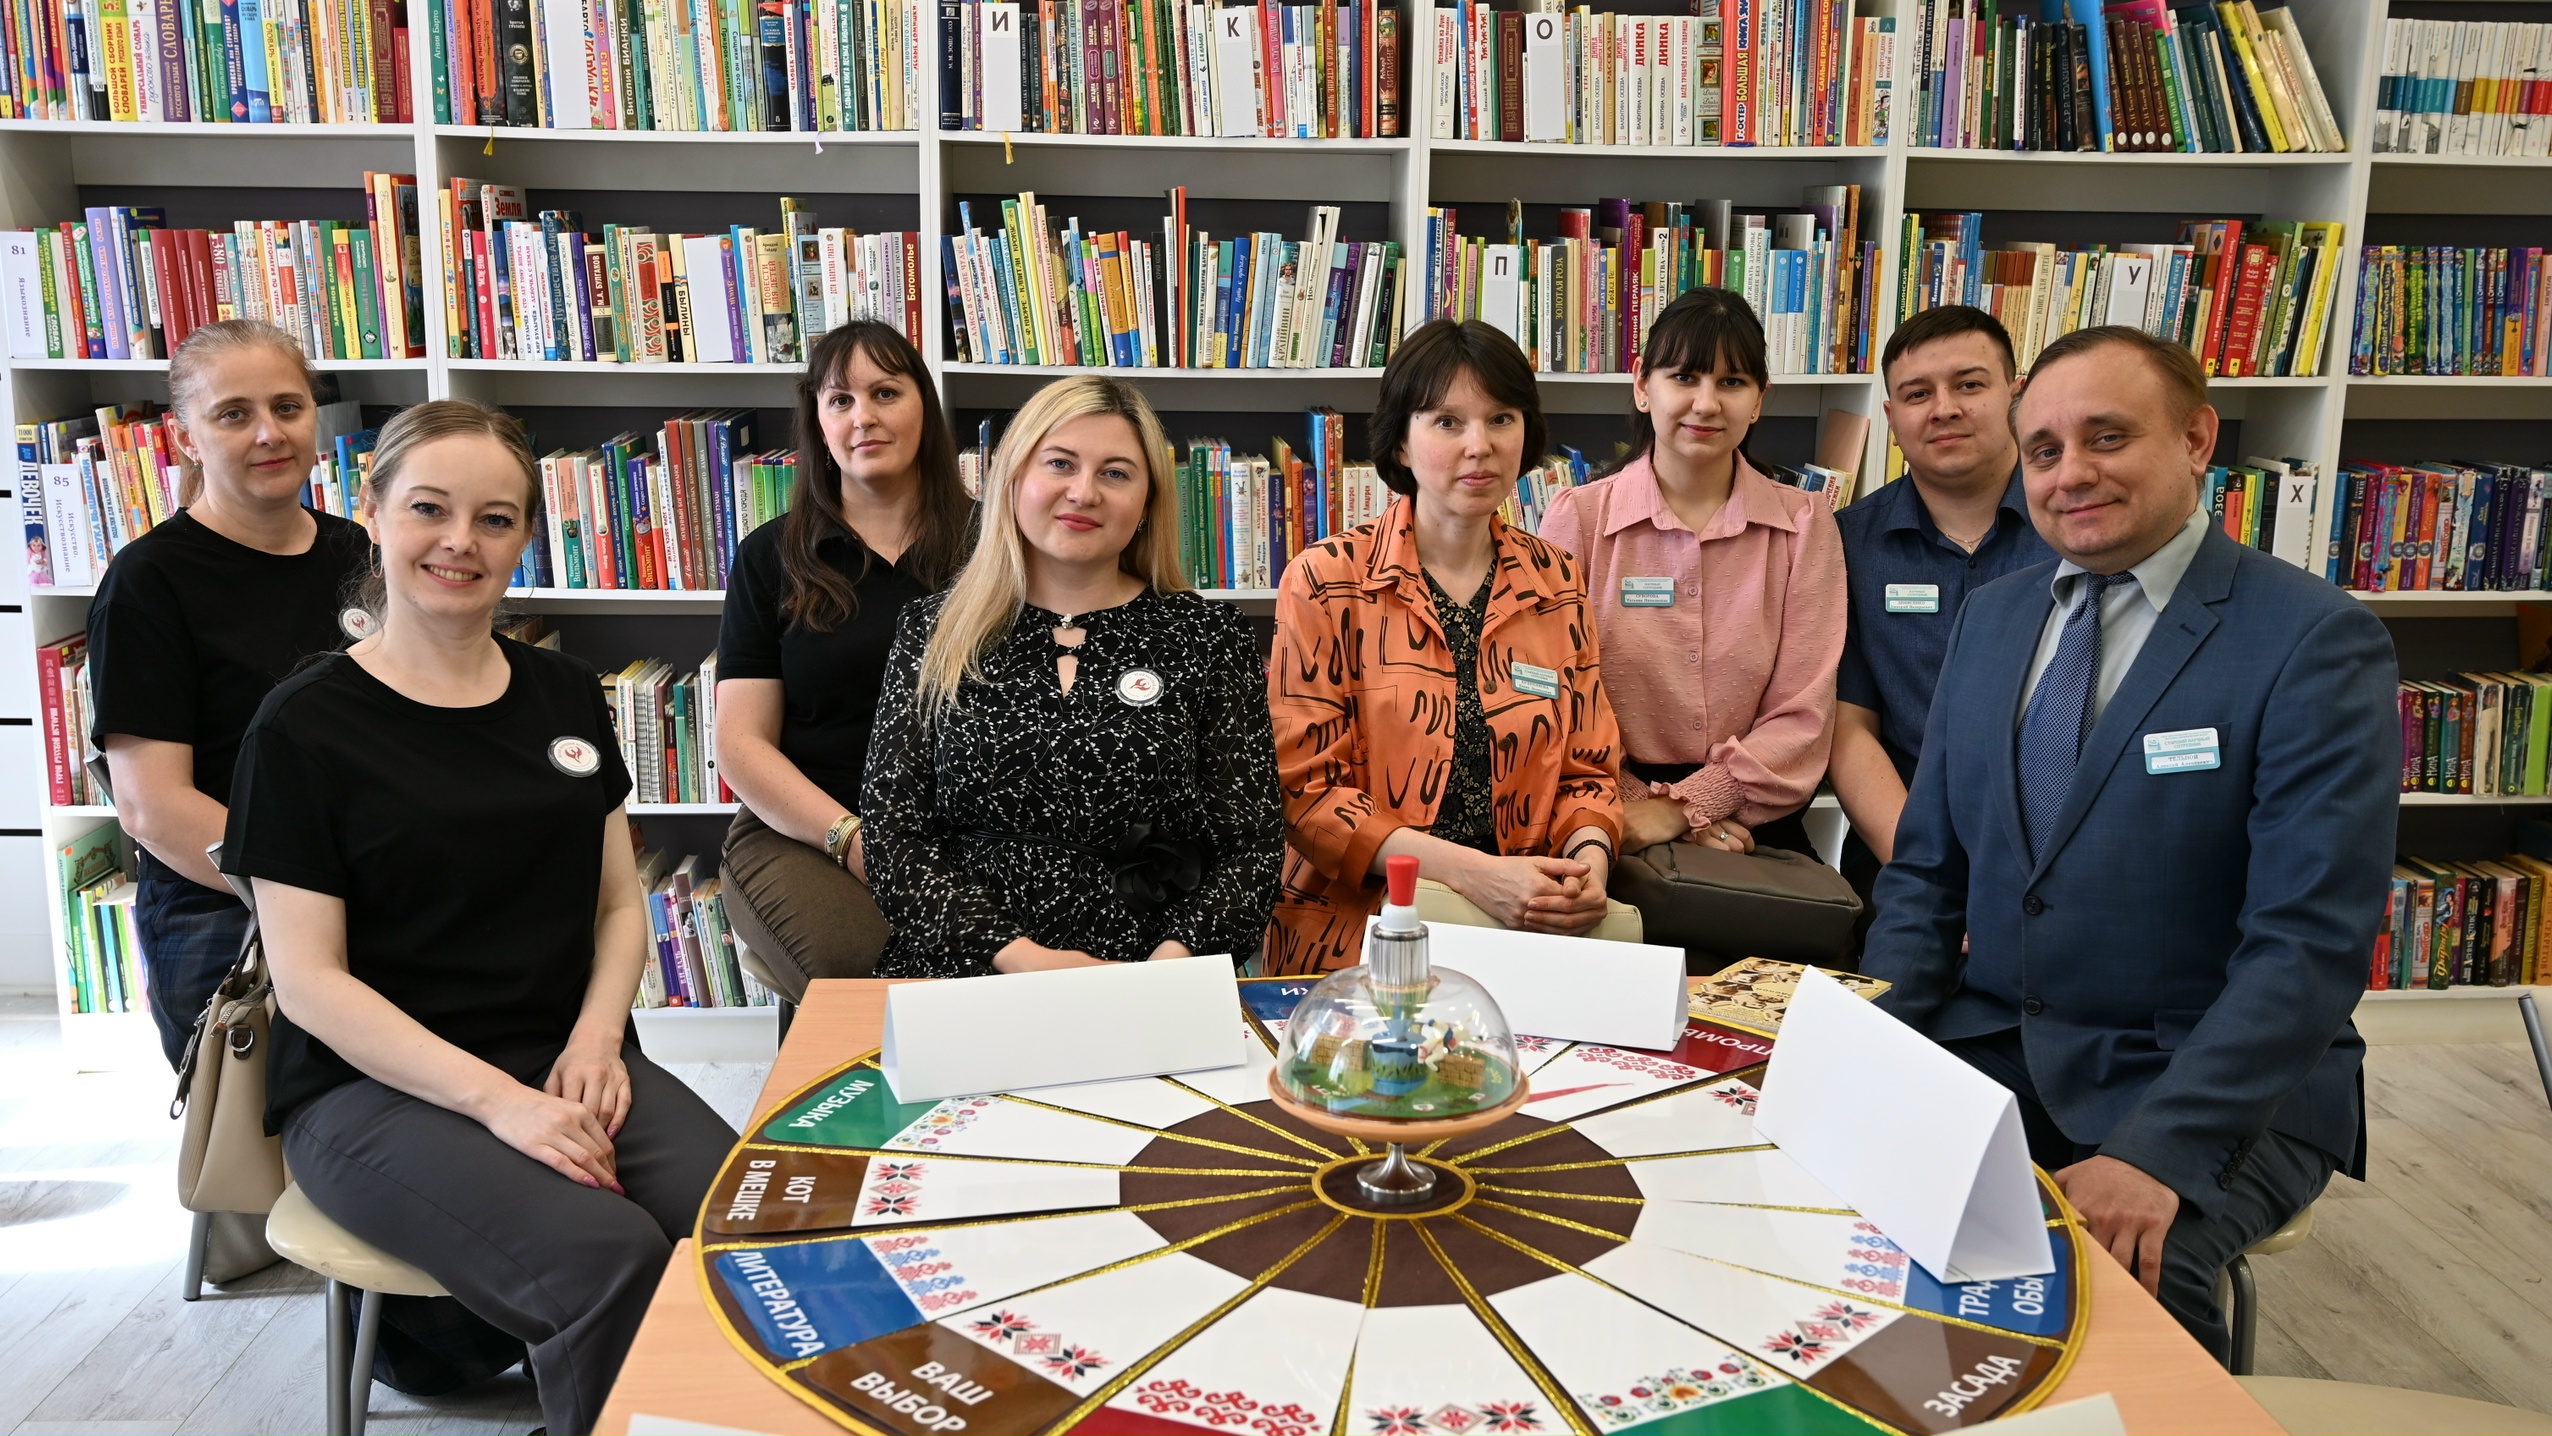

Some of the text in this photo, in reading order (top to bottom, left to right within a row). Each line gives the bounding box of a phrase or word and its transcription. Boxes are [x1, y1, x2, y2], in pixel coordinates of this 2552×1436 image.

[265, 23, 274, 57] СЛОВАРЬ
[432, 10, 442, 59] Агния Барто
[992, 10, 1009, 32] И
[1226, 16, 1240, 38] К
[1536, 19, 1552, 40] О
[1821, 14, 1829, 56] ВРЕДНЫЕ
[840, 14, 852, 108] БОЛЬШАЯ КНИГА ЛЕСНЫХ ЖИВОТНЫХ
[1635, 22, 1645, 66] ДИНКА
[1659, 22, 1668, 66] ДИНКА
[1737, 21, 1748, 101] БОЛЬШАЯ КНИГА
[105, 22, 120, 114] БОЛЬШОЙ СБОРНИК
[132, 20, 148, 114] УНИВЕРСАЛЬНЫЙ СЛОВАРЬ
[143, 32, 159, 103] русского языка
[600, 51, 610, 93] СТИХИ
[620, 18, 634, 115] Виталий БИАНКИ
[1386, 47, 1394, 88] КИПЛИНГ
[119, 67, 130, 114] СЛОВАРЕЙ
[172, 62, 183, 117] РУССКОГО ЯЗЫКА
[2166, 85, 2182, 134] ЛЕВ ТОЛСТОЙ
[495, 202, 522, 217] Земля
[11, 245, 26, 255] 81
[957, 244, 968, 272] ЧУДЕС
[1008, 223, 1019, 252] КРОКУС
[1446, 221, 1454, 276] 38 ПОПУГАЕВ
[1747, 232, 1755, 263] ЗДОРОВЬЕ
[42, 234, 57, 312] РУССКО-АНГЛИЙСКИЙ
[546, 220, 564, 320] Путешествие Алисы
[592, 255, 605, 305] М.А. БУЛГАКОВ
[762, 263, 770, 304] ПОВЕСТИ
[768, 260, 779, 307] ДЛЯ ДЕТЕЙ
[963, 274, 972, 301] СТРАНЕ
[1494, 256, 1508, 276] П
[2035, 254, 2051, 315] КНИГА ДЛЯ ДЕТЕЙ
[2128, 265, 2142, 285] У
[18, 277, 31, 337] Языкознание
[296, 270, 311, 330] ХРЕСТОМАТИЯ
[326, 256, 340, 327] ЗАВЕТНОЕ СЛОВО
[906, 243, 918, 336] Шмелев Богомолье
[1555, 257, 1564, 361] Паустовский ЗОЛОТАЯ РОЗА
[1851, 298, 1859, 324] ПОГОДИН
[1900, 268, 1908, 312] УШИНСКИЙ
[49, 314, 60, 352] СЛОВАРЬ
[678, 290, 690, 336] БЫЛИНЫ
[968, 310, 978, 337] АЛИСА
[1277, 307, 1291, 361] КРАПИВИН
[1631, 271, 1639, 354] Евгений ПЕРМЯК
[1232, 335, 1240, 351] Виктор
[19, 460, 44, 525] ДЕВОЧЕК
[53, 475, 70, 487] 85
[102, 478, 112, 505] МАЛЬЧИКОВ
[740, 490, 748, 511] ГОРОДА
[1347, 486, 1356, 512] Линдгрен
[1363, 485, 1371, 511] Линдгрен
[2290, 484, 2304, 503] Х
[82, 459, 106, 560] АЗБУКА ВЫШИВАНИЯ
[110, 516, 118, 538] ПОДЕЛКИ
[56, 499, 70, 572] Искусствознание
[573, 545, 581, 582] ВИЛЬМОНТ
[645, 545, 654, 582] ВИЛЬМОНТ
[788, 1079, 875, 1128] МУЗЫКА
[726, 1160, 777, 1221] В МЕШКЕ
[782, 1176, 817, 1203] КОТ
[731, 1251, 826, 1358] ЛИТЕРАТУРА
[2012, 1276, 2045, 1316] ОБЫ
[850, 1371, 967, 1432] ВЫБОР
[910, 1360, 994, 1406] ВАШ
[1923, 1354, 2022, 1418] ЗАСАДА
